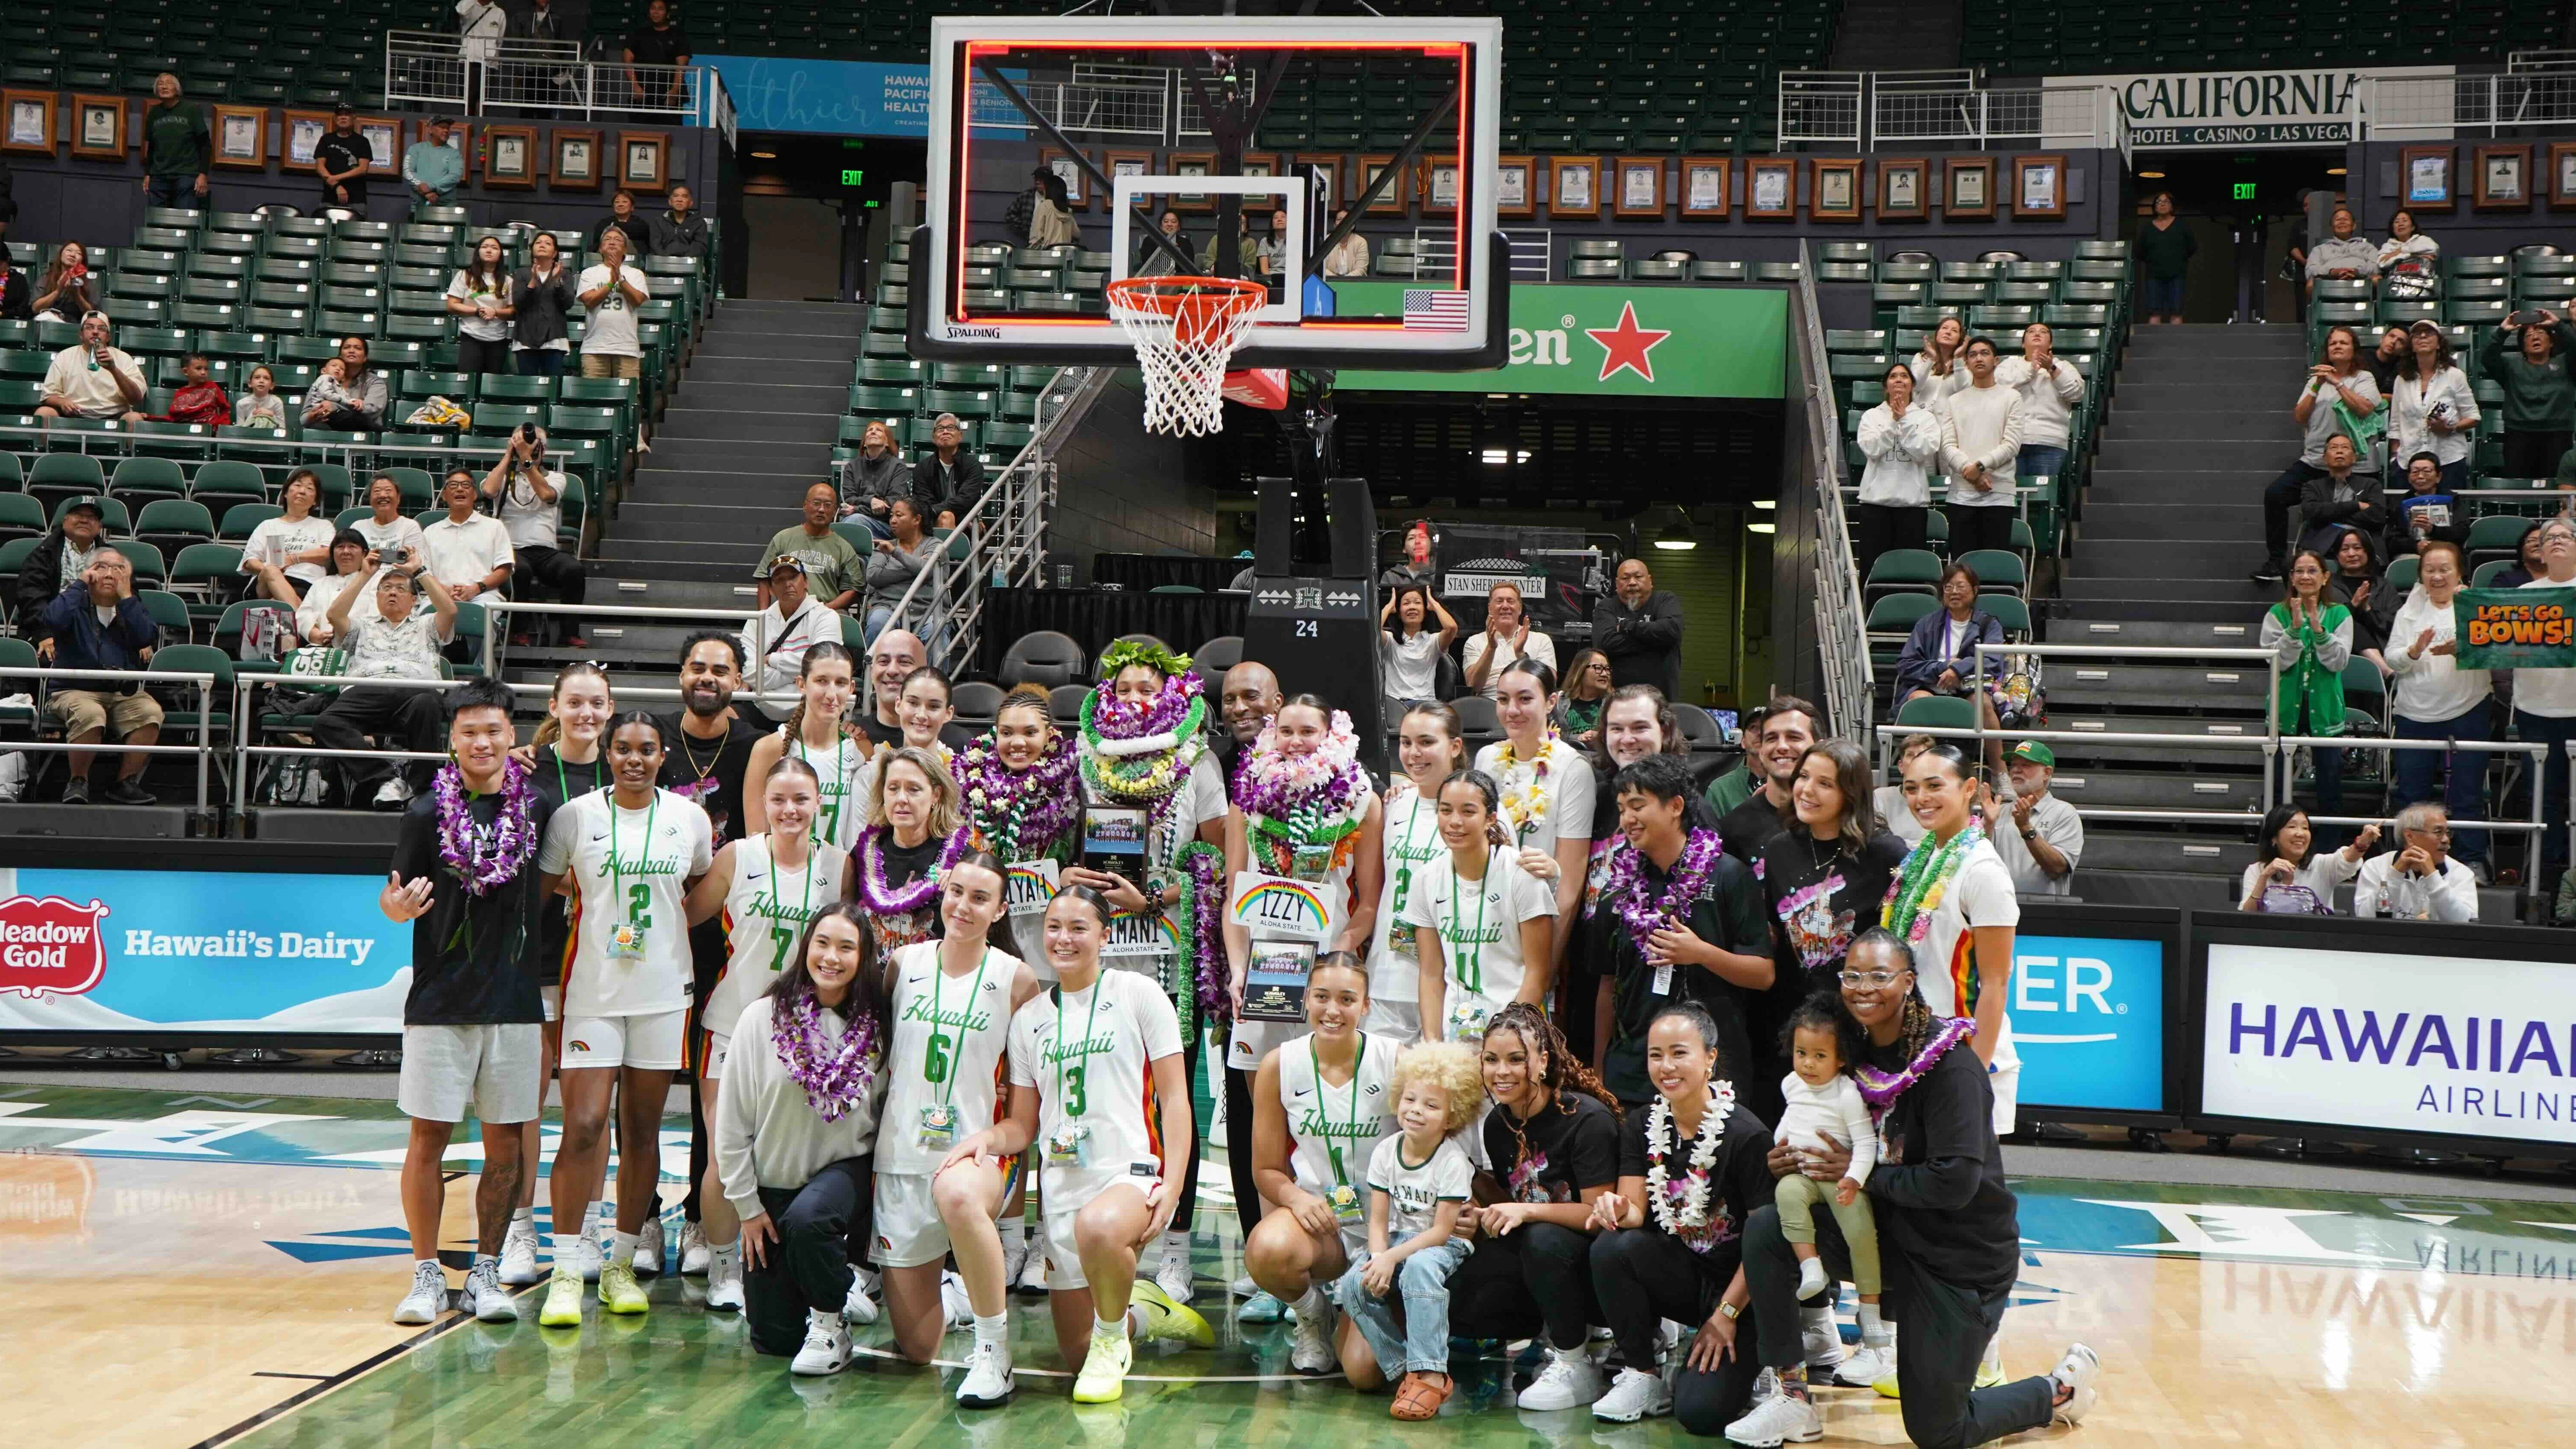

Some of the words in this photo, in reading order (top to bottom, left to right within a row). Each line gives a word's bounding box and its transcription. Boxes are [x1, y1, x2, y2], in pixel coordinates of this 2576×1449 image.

[884, 89, 930, 99] PACIFI
[885, 75, 930, 86] HAWAI
[2125, 74, 2366, 119] CALIFORNIA
[2131, 129, 2180, 144] HOTEL
[2194, 127, 2257, 143] CASINO
[2270, 126, 2303, 141] LAS
[2305, 125, 2351, 140] VEGA
[841, 170, 863, 186] EXIT
[2234, 183, 2256, 200] EXIT
[602, 297, 623, 311] 23
[947, 327, 1000, 339] SPALDING
[1509, 328, 1572, 365] en
[1448, 577, 1469, 591] STAN
[1471, 578, 1504, 592] SHER
[2533, 604, 2564, 621] GO
[1296, 620, 1318, 637] 24
[2469, 617, 2574, 645] BOWS!
[310, 647, 329, 676] BOW
[814, 804, 839, 846] 7
[1387, 835, 1448, 861] Hawai
[597, 850, 679, 878] Hawaii
[1008, 873, 1047, 905] IYAH
[1269, 879, 1304, 891] HAWAII
[1393, 868, 1412, 913] 2
[629, 884, 652, 928] 2
[745, 890, 820, 923] Hawai
[1261, 889, 1306, 922] IZZY
[1108, 916, 1159, 944] IMANI
[1260, 920, 1281, 929] ALOHA
[1282, 923, 1302, 931] STATE
[3, 944, 68, 968] Gold
[124, 930, 273, 958] Hawaii's
[278, 931, 374, 966] Dairy
[770, 927, 793, 971] 7
[2016, 955, 2114, 1014] ER
[902, 995, 990, 1032] Hawaii
[1041, 1030, 1115, 1070] Hawaii
[2229, 1003, 2576, 1078] HAWAIIA
[924, 1033, 952, 1084] 6
[1065, 1066, 1087, 1117] 3
[1297, 1108, 1382, 1138] Hawaii
[1393, 1185, 1438, 1207] AWAI'I
